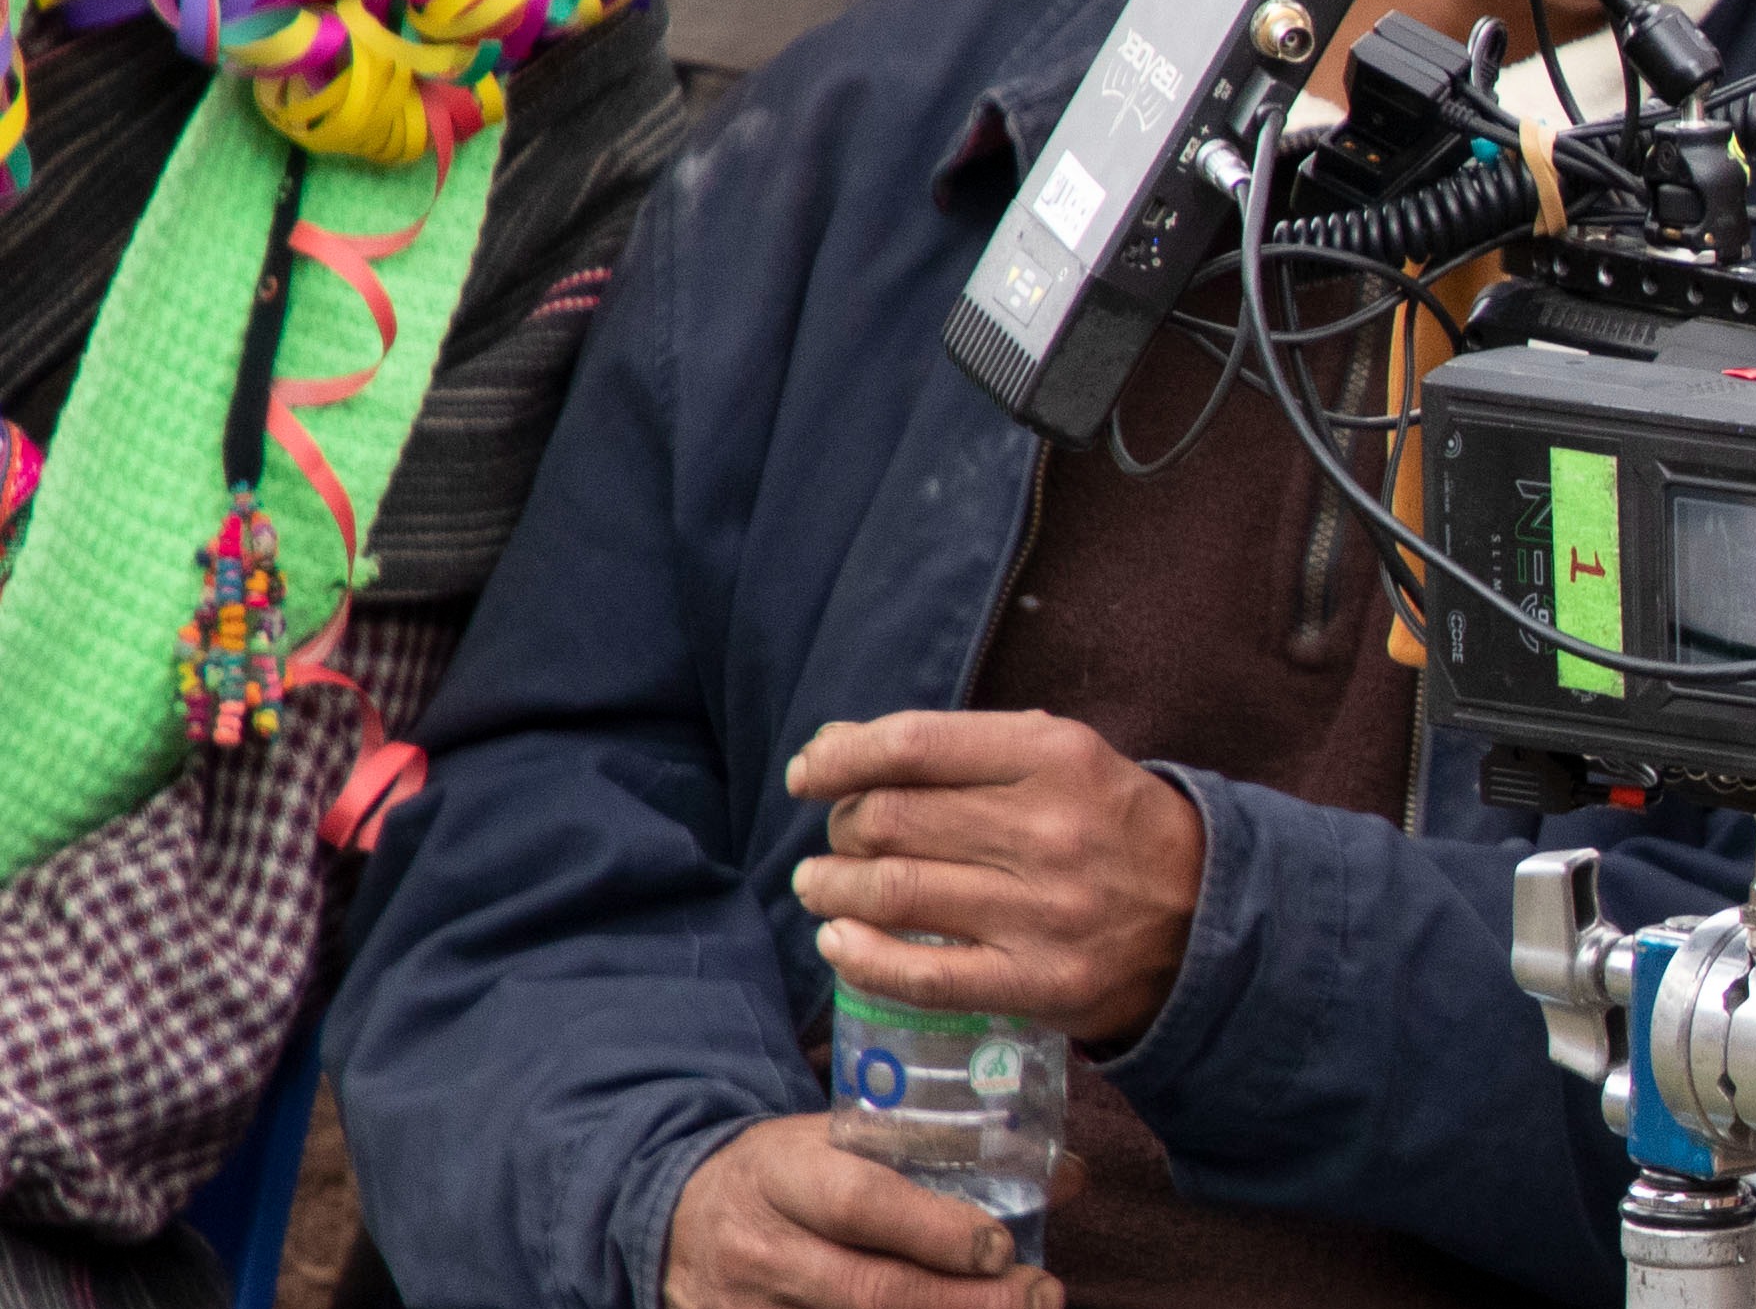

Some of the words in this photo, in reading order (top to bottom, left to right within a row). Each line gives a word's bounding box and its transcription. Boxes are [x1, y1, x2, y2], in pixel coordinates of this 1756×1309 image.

[1117, 27, 1184, 102] TERADEK
[1570, 546, 1606, 584] 1
[1448, 610, 1465, 664] CORE
